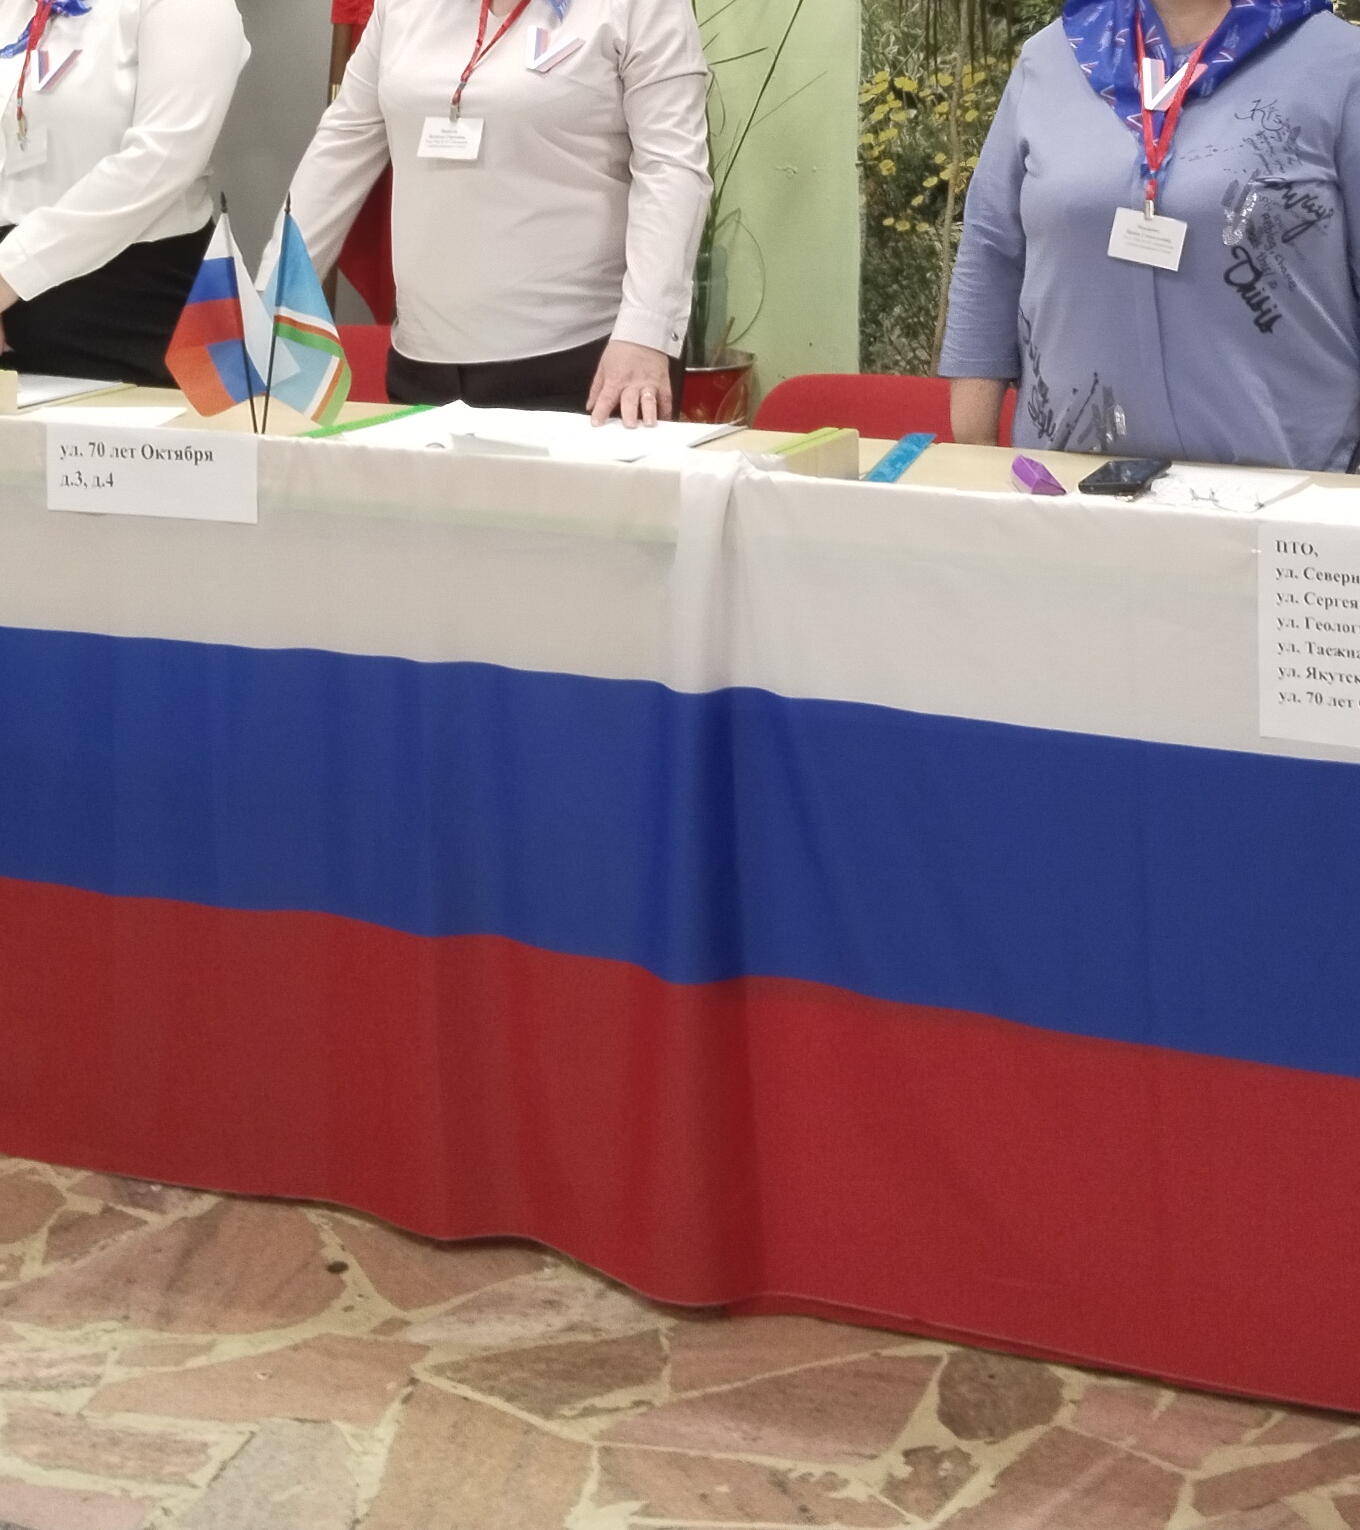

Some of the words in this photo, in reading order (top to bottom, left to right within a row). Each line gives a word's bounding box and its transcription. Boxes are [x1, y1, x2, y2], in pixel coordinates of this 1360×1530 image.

[60, 445, 83, 460] ул.
[89, 442, 105, 458] 70
[110, 447, 136, 459] лет
[141, 444, 213, 465] Октября
[60, 470, 87, 488] д.3,
[92, 472, 114, 488] д.4
[1275, 538, 1318, 558] ПТО,
[1275, 566, 1298, 581] ул.
[1276, 591, 1299, 605] ул.
[1303, 592, 1358, 610] Сергея
[1276, 616, 1299, 630] ул.
[1277, 641, 1300, 655] ул.
[1278, 666, 1301, 680] ул.
[1279, 691, 1301, 704] ул.
[1306, 691, 1323, 706] 70
[1327, 696, 1353, 709] лет
